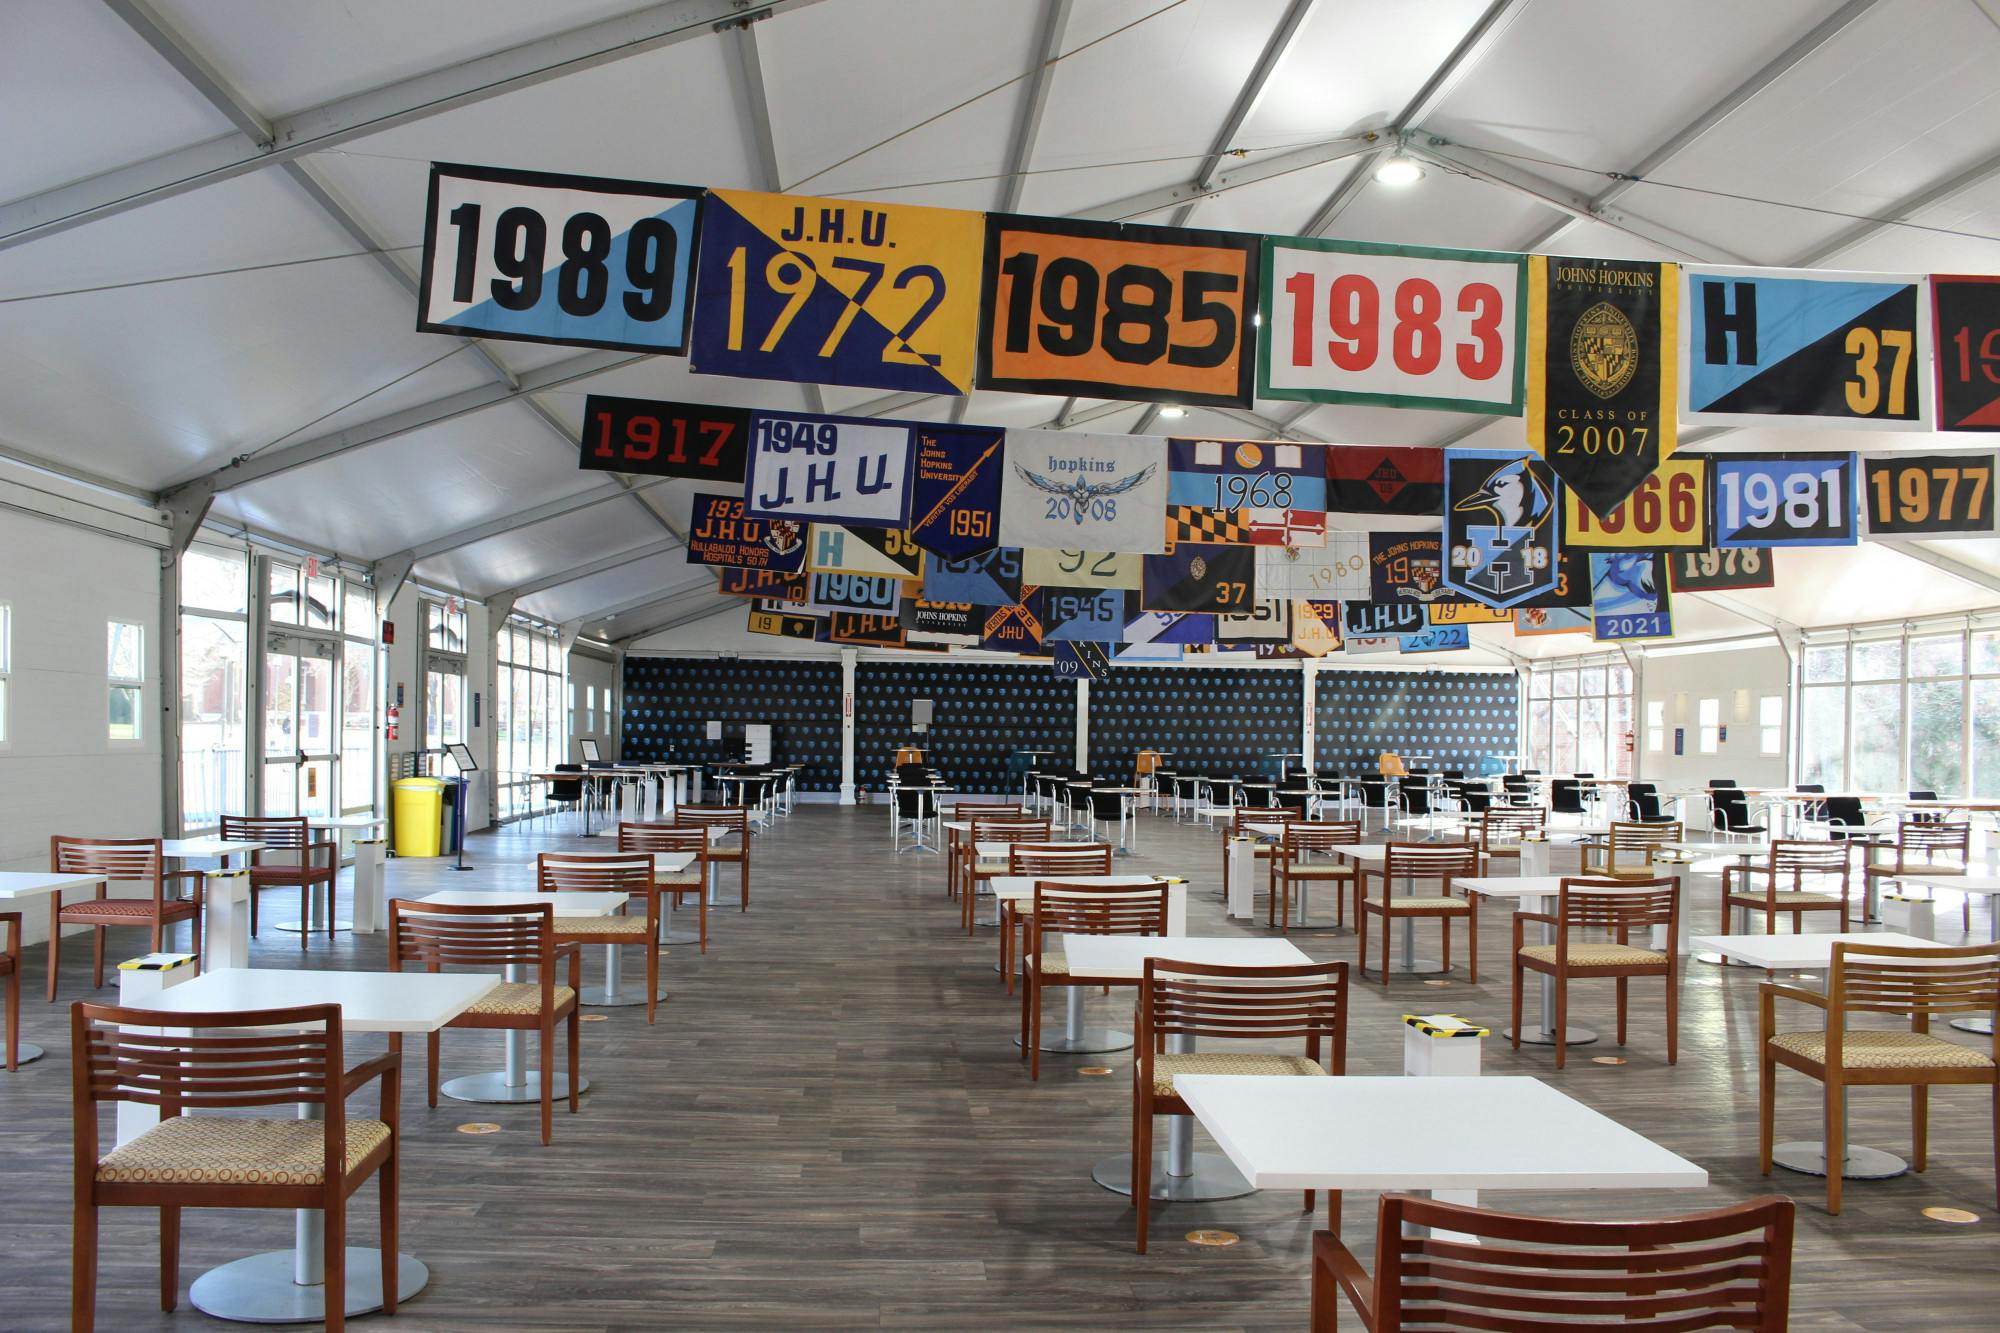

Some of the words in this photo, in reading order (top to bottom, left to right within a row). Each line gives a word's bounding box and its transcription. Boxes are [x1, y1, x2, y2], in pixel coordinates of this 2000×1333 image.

[780, 207, 897, 249] J.H.U.
[450, 203, 678, 322] 1989
[1556, 266, 1596, 284] JOHNS
[1599, 269, 1654, 288] HOPKINS
[726, 246, 948, 367] 1972
[1002, 252, 1238, 368] 1985
[1285, 272, 1505, 380] 1983
[1703, 281, 1758, 366] H
[1844, 326, 1912, 415] 37
[1558, 409, 1617, 421] CLASS
[1627, 409, 1648, 422] OF
[594, 411, 737, 467] 1917
[757, 419, 838, 456] 1949
[1556, 426, 1649, 457] 2007
[920, 458, 953, 470] HOPKINS
[1211, 471, 1293, 514] 1968
[1720, 468, 1842, 529] 1981
[1871, 467, 1990, 524] 1977
[695, 518, 763, 543] J.H.U.
[949, 508, 992, 538] 1951
[739, 545, 769, 558] HONORS
[817, 530, 845, 567] H
[1372, 552, 1387, 566] THE
[1386, 542, 1409, 559] JOHNS
[1409, 540, 1440, 551] HOPKINS
[1684, 548, 1761, 579] 1978
[1308, 555, 1364, 589] 1980
[1385, 556, 1409, 584] 19
[817, 572, 893, 605] 1960
[1215, 581, 1247, 604] 37
[915, 610, 938, 621] JOHNS
[938, 612, 968, 623] HOPKINS
[1050, 596, 1115, 622] 1945
[998, 625, 1025, 640] JHU
[1607, 617, 1661, 636] 2021
